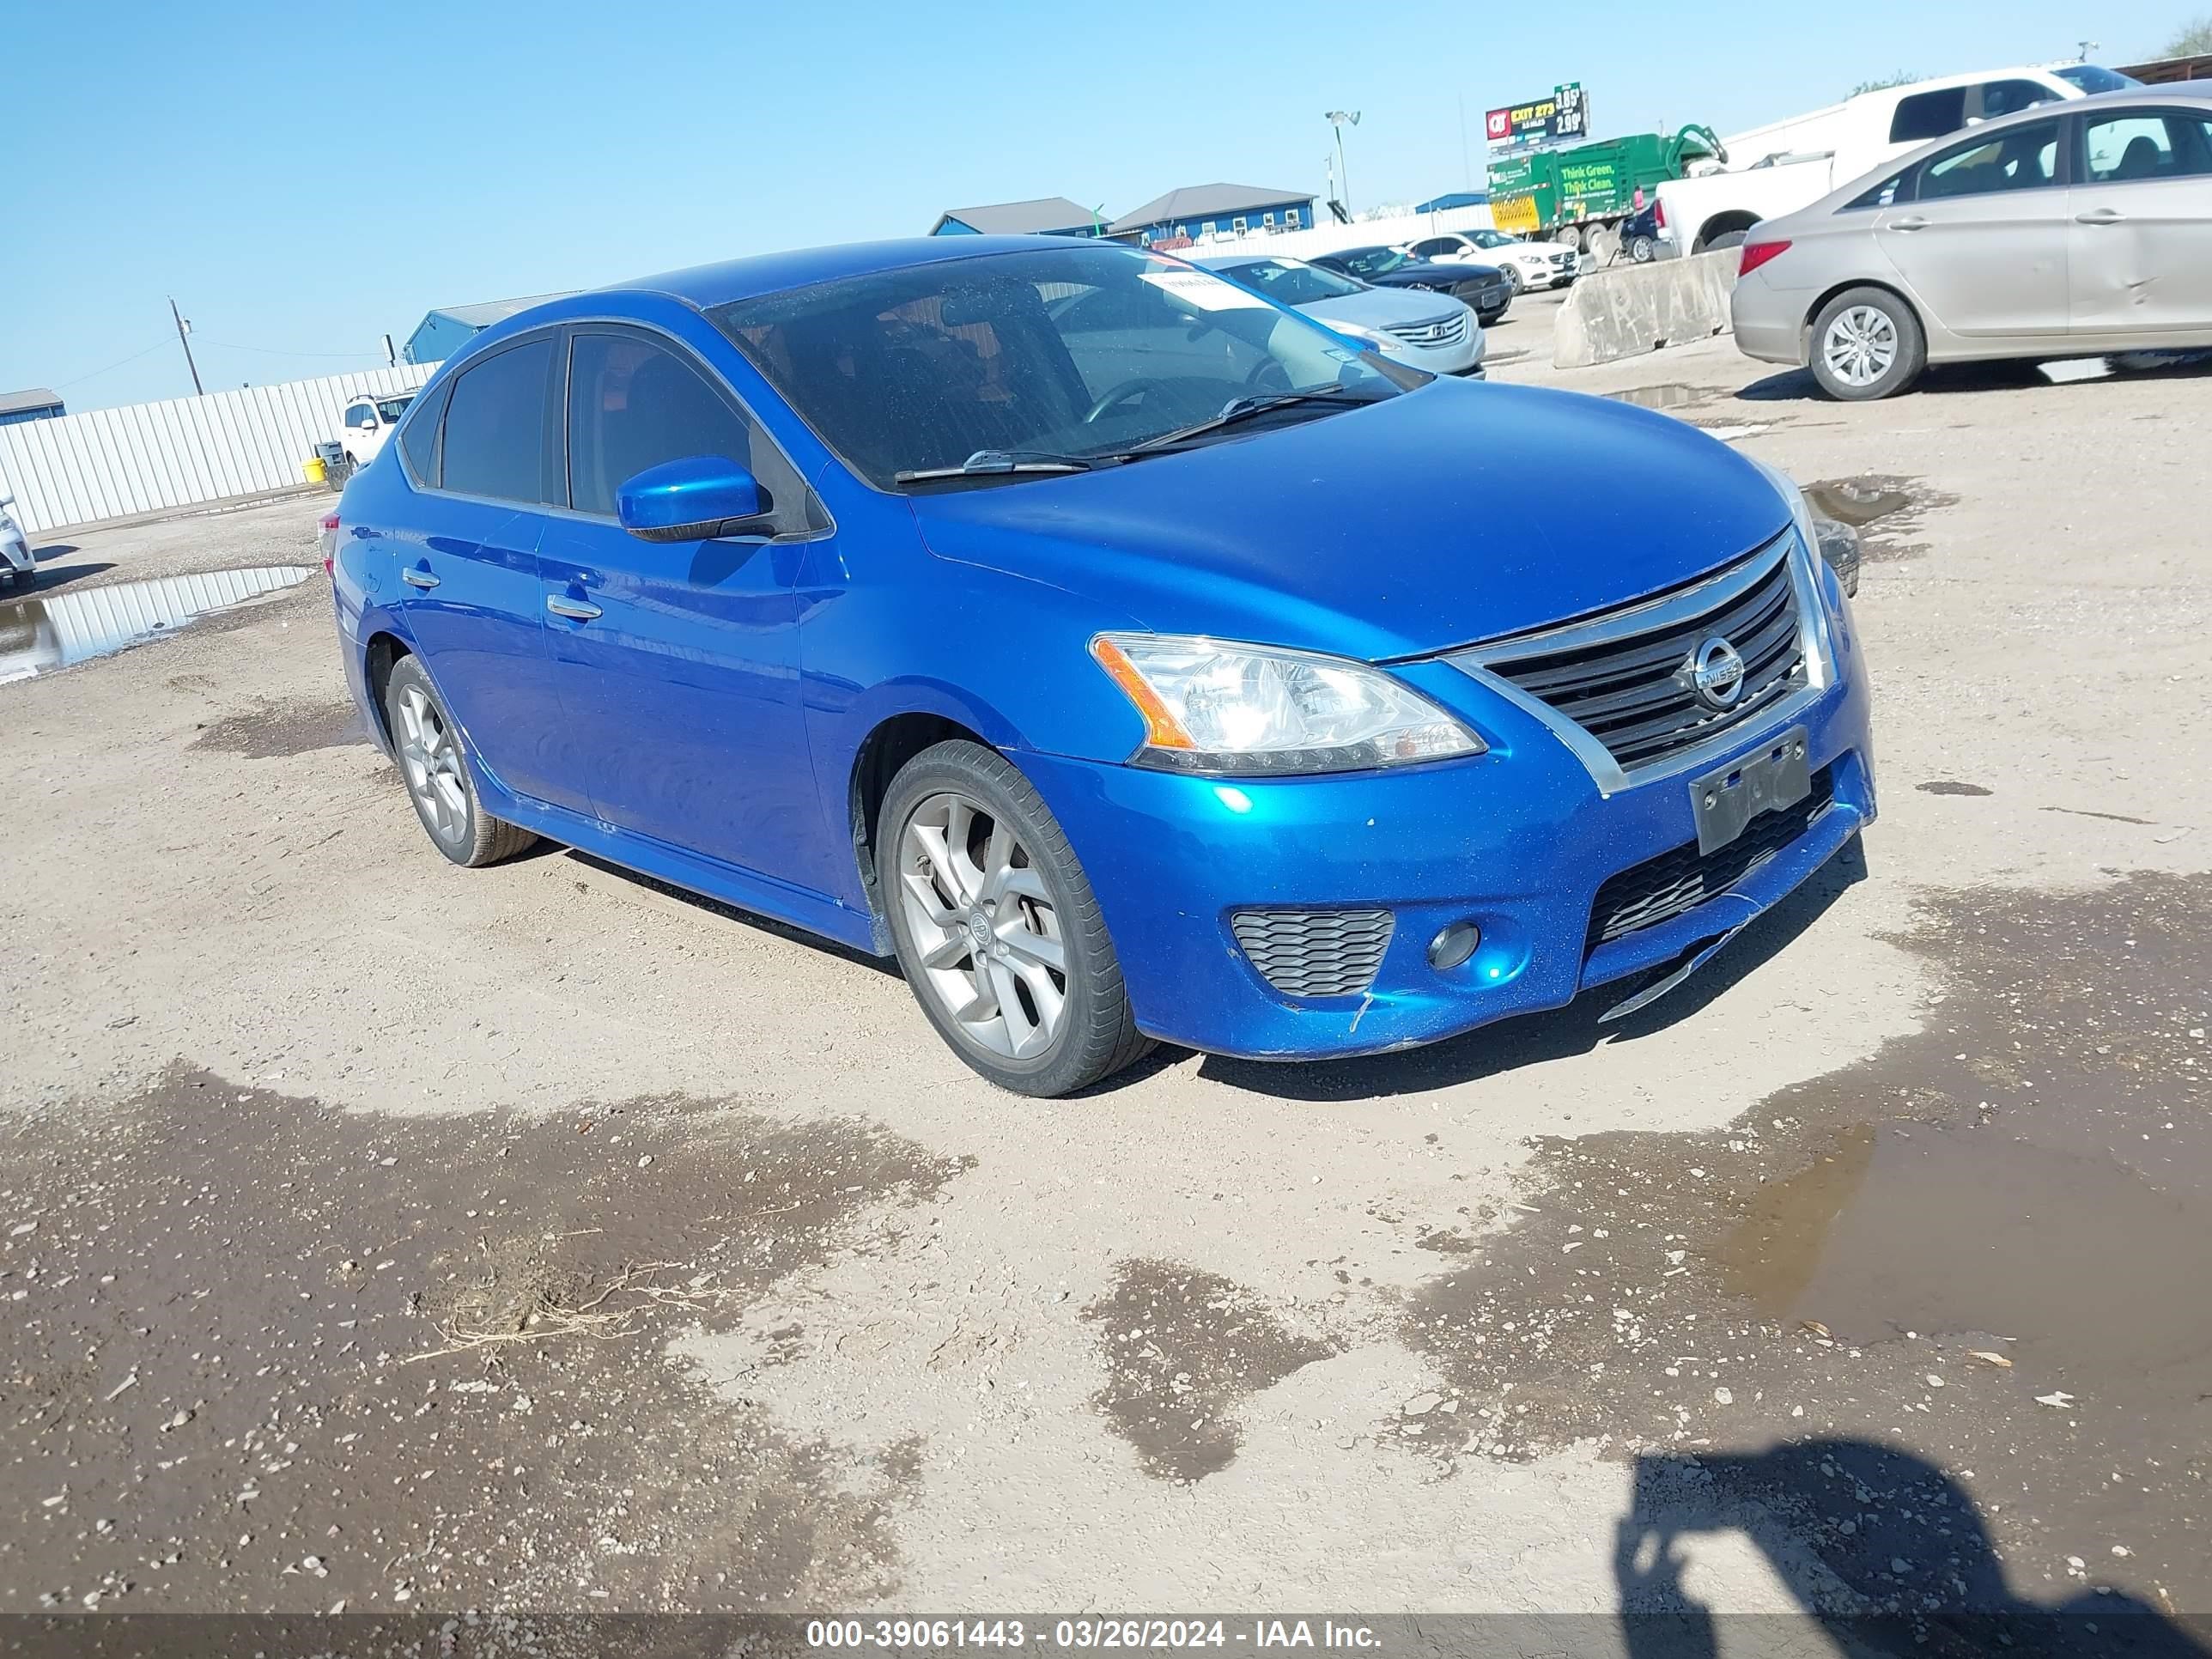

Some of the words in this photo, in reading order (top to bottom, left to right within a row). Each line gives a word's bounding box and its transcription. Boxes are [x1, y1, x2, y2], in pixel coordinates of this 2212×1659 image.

[1511, 107, 1534, 122] EXIT
[1535, 102, 1555, 118] 273
[1489, 113, 1506, 133] QT
[1561, 167, 1586, 179] Think
